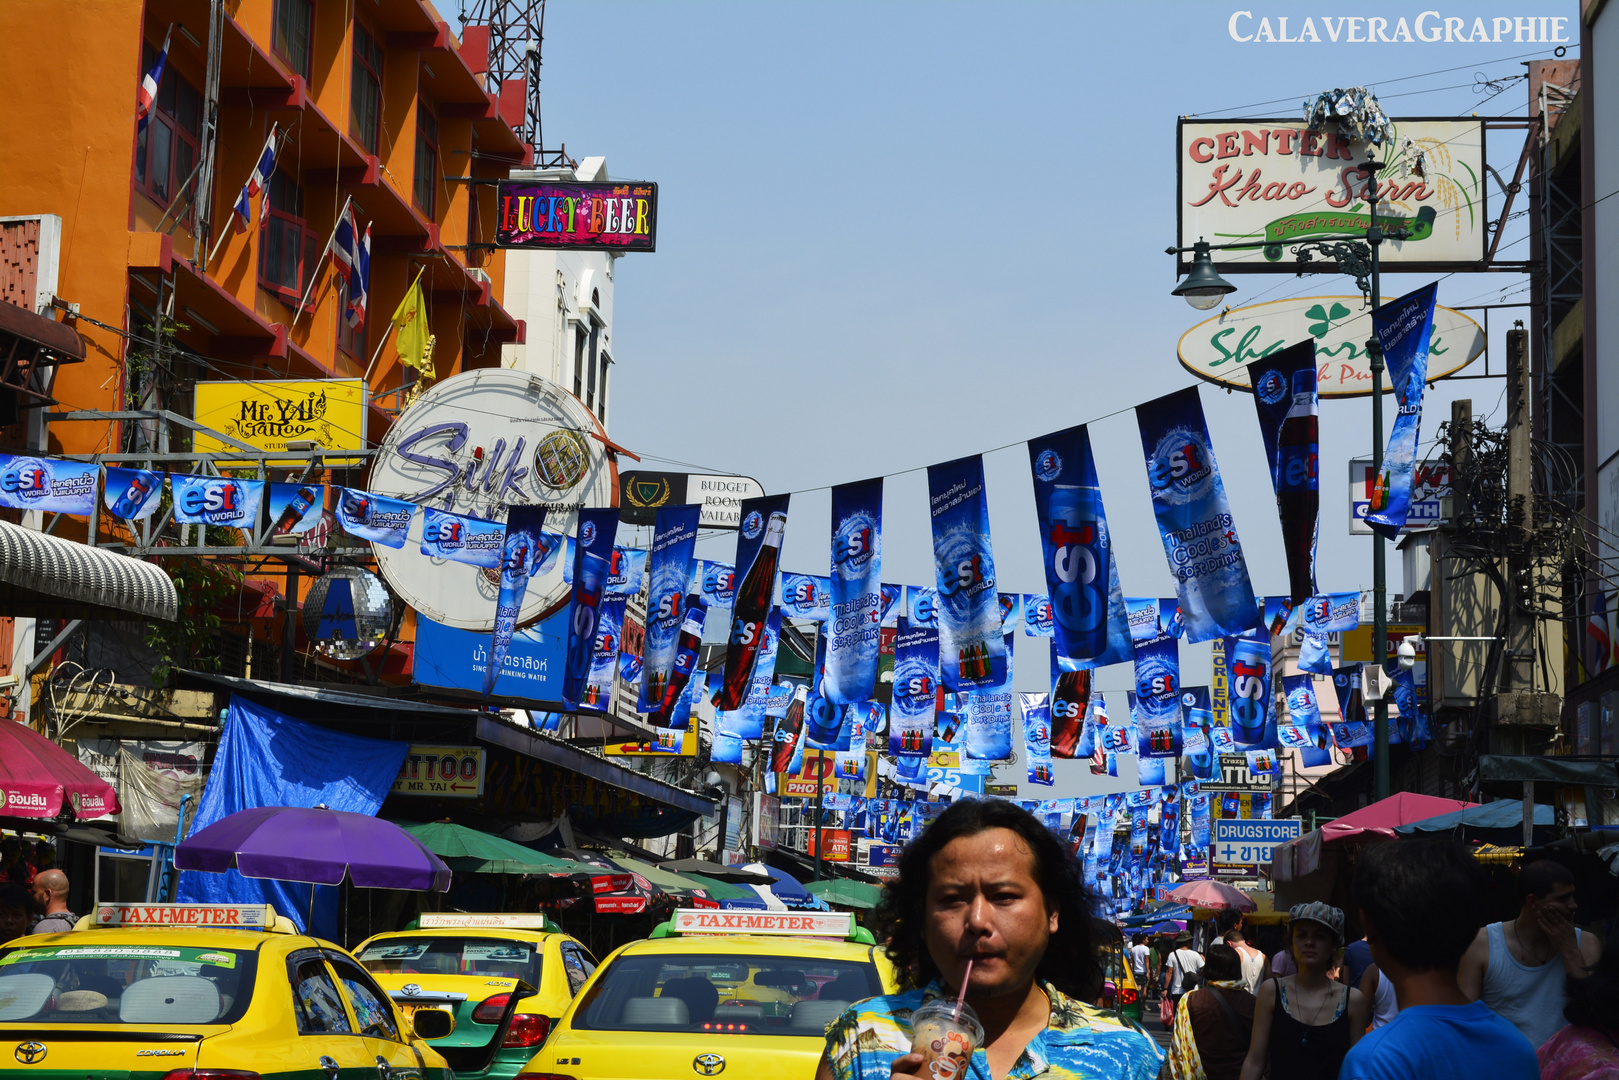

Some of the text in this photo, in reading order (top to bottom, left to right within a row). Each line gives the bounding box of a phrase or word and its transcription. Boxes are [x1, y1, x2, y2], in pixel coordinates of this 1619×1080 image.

[1188, 128, 1353, 163] CENTER
[1187, 163, 1316, 207] Khao
[501, 196, 649, 234] LUCKY BEER
[396, 420, 530, 503] Silk
[1035, 457, 1055, 475] est
[1151, 444, 1201, 488] est
[1285, 450, 1317, 486] est
[0, 469, 44, 492] est
[1181, 466, 1212, 487] WORLD
[24, 488, 50, 498] WORLD
[700, 480, 750, 493] BUDGET
[117, 477, 150, 520] est
[180, 484, 236, 515] est
[344, 494, 369, 518] st
[210, 510, 246, 523] WORLD
[347, 516, 370, 525] WORLD
[425, 523, 460, 542] est
[1100, 521, 1108, 549] COLA
[1165, 513, 1232, 547] Thailand's
[833, 528, 870, 564] est
[1172, 530, 1237, 566] Coolest
[853, 549, 875, 566] WORLD
[938, 555, 982, 597] est
[1177, 551, 1243, 584] Soft Drink
[703, 573, 735, 593] est
[966, 579, 995, 599] WORLD
[783, 584, 814, 604] est
[647, 593, 681, 624] est
[833, 594, 878, 617] Thailand's
[1025, 604, 1053, 624] est
[1305, 602, 1328, 623] est
[833, 610, 878, 634] Coolest
[1040, 620, 1054, 628] WOR
[1317, 616, 1332, 625] WORLD
[731, 619, 763, 646] est
[832, 635, 852, 651] Soft
[852, 629, 878, 646] Drink
[595, 635, 613, 651] st
[676, 653, 692, 669] st
[473, 664, 546, 682] SING WATER
[894, 677, 930, 697] est
[1137, 675, 1173, 698] est
[1158, 691, 1179, 701] WORLD
[1229, 660, 1265, 729] est
[913, 694, 936, 702] WORLD
[971, 693, 1011, 704] Thailand's
[1289, 694, 1311, 710] est
[867, 708, 879, 728] est
[971, 704, 1011, 715] Coolest
[971, 714, 1011, 724] Soft Drink
[1053, 700, 1085, 719] est
[774, 730, 798, 745] est
[851, 723, 862, 736] st
[1028, 727, 1047, 742] est
[1102, 729, 1128, 749] est
[1213, 727, 1231, 746] est
[1280, 728, 1303, 743] est
[408, 783, 427, 791] MR.
[430, 783, 447, 791] YAI
[1132, 791, 1151, 802] est
[9, 794, 47, 806] ออมสิน
[82, 795, 105, 807] ออมสิน
[872, 801, 889, 812] est
[1224, 801, 1237, 810] est
[1219, 826, 1298, 838] DRUGSTORE
[832, 844, 848, 852] ATM
[118, 907, 240, 925] TAXI-METER
[697, 914, 815, 930] TAXI-METER
[484, 980, 512, 988] ALTIS
[136, 1049, 186, 1057] COROLLA
